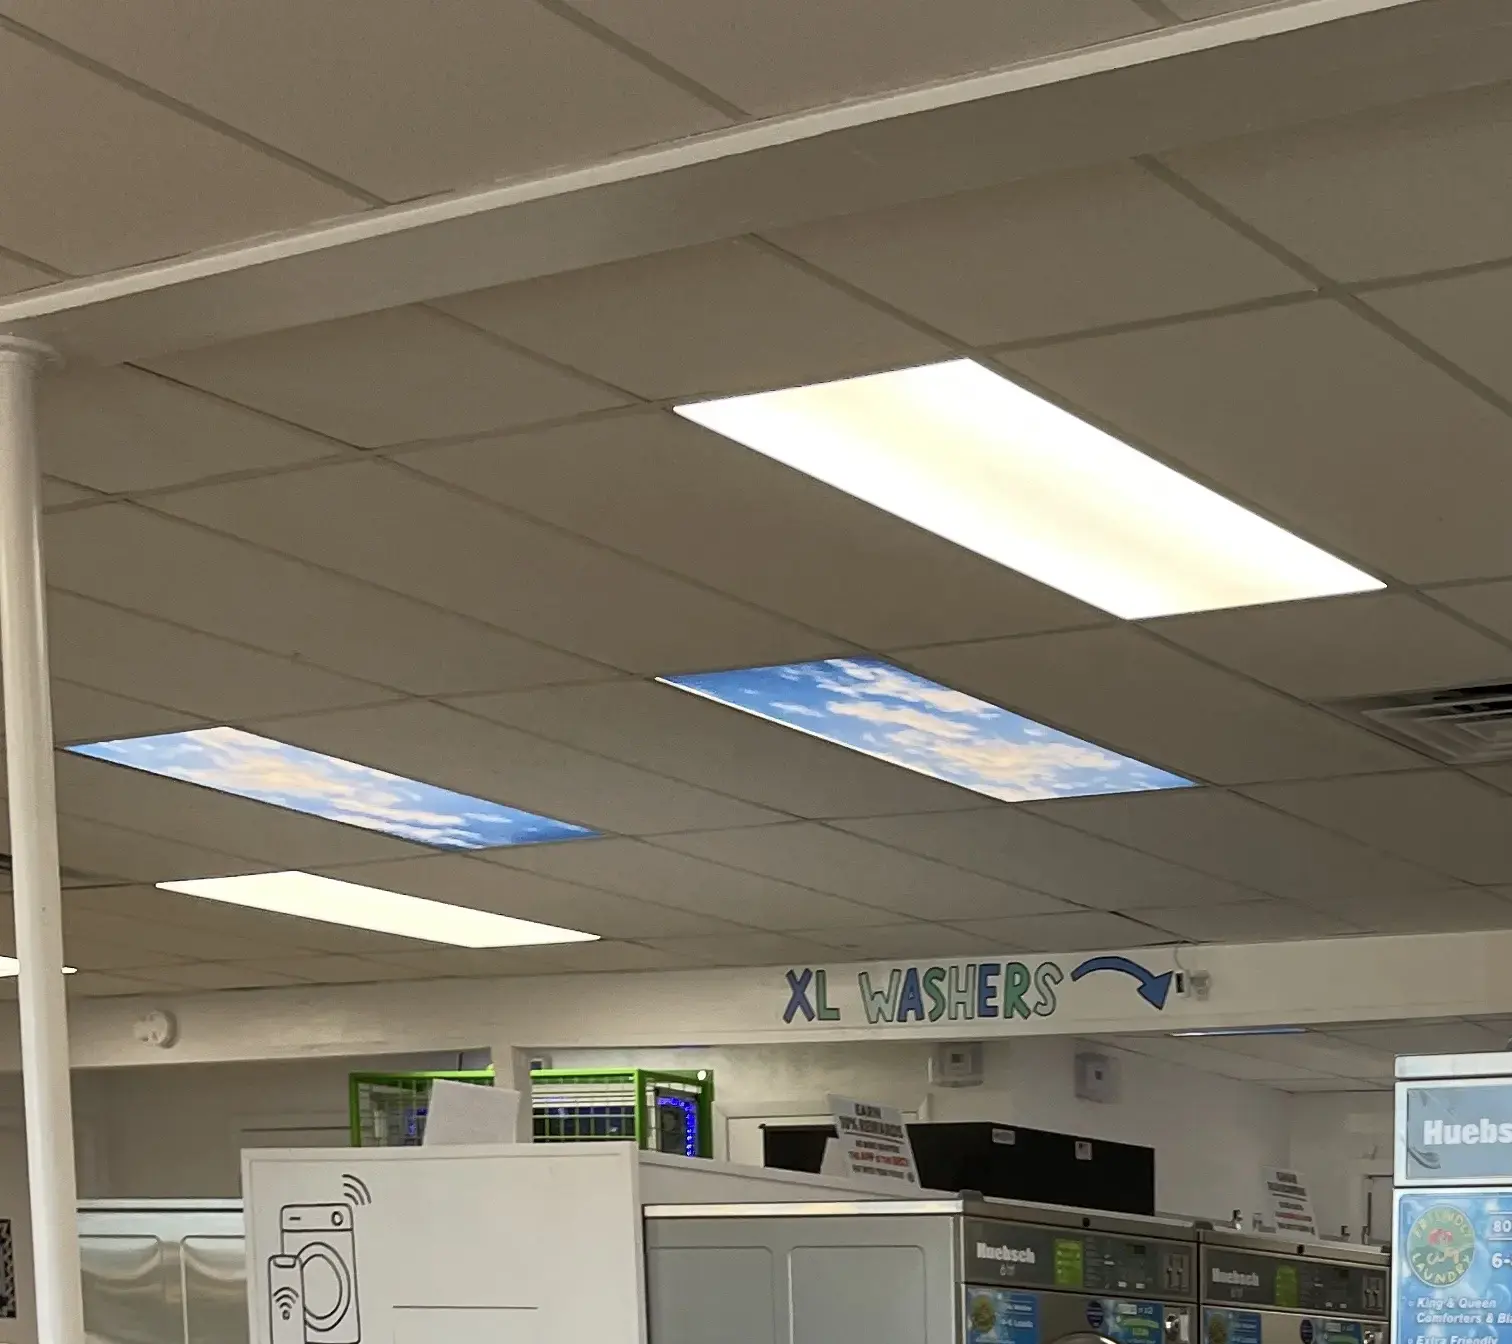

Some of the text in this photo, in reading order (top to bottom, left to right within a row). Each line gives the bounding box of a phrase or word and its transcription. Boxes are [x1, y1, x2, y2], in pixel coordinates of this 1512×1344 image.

[783, 961, 1064, 1024] XL WASHERS
[1417, 1312, 1483, 1324] Comforters
